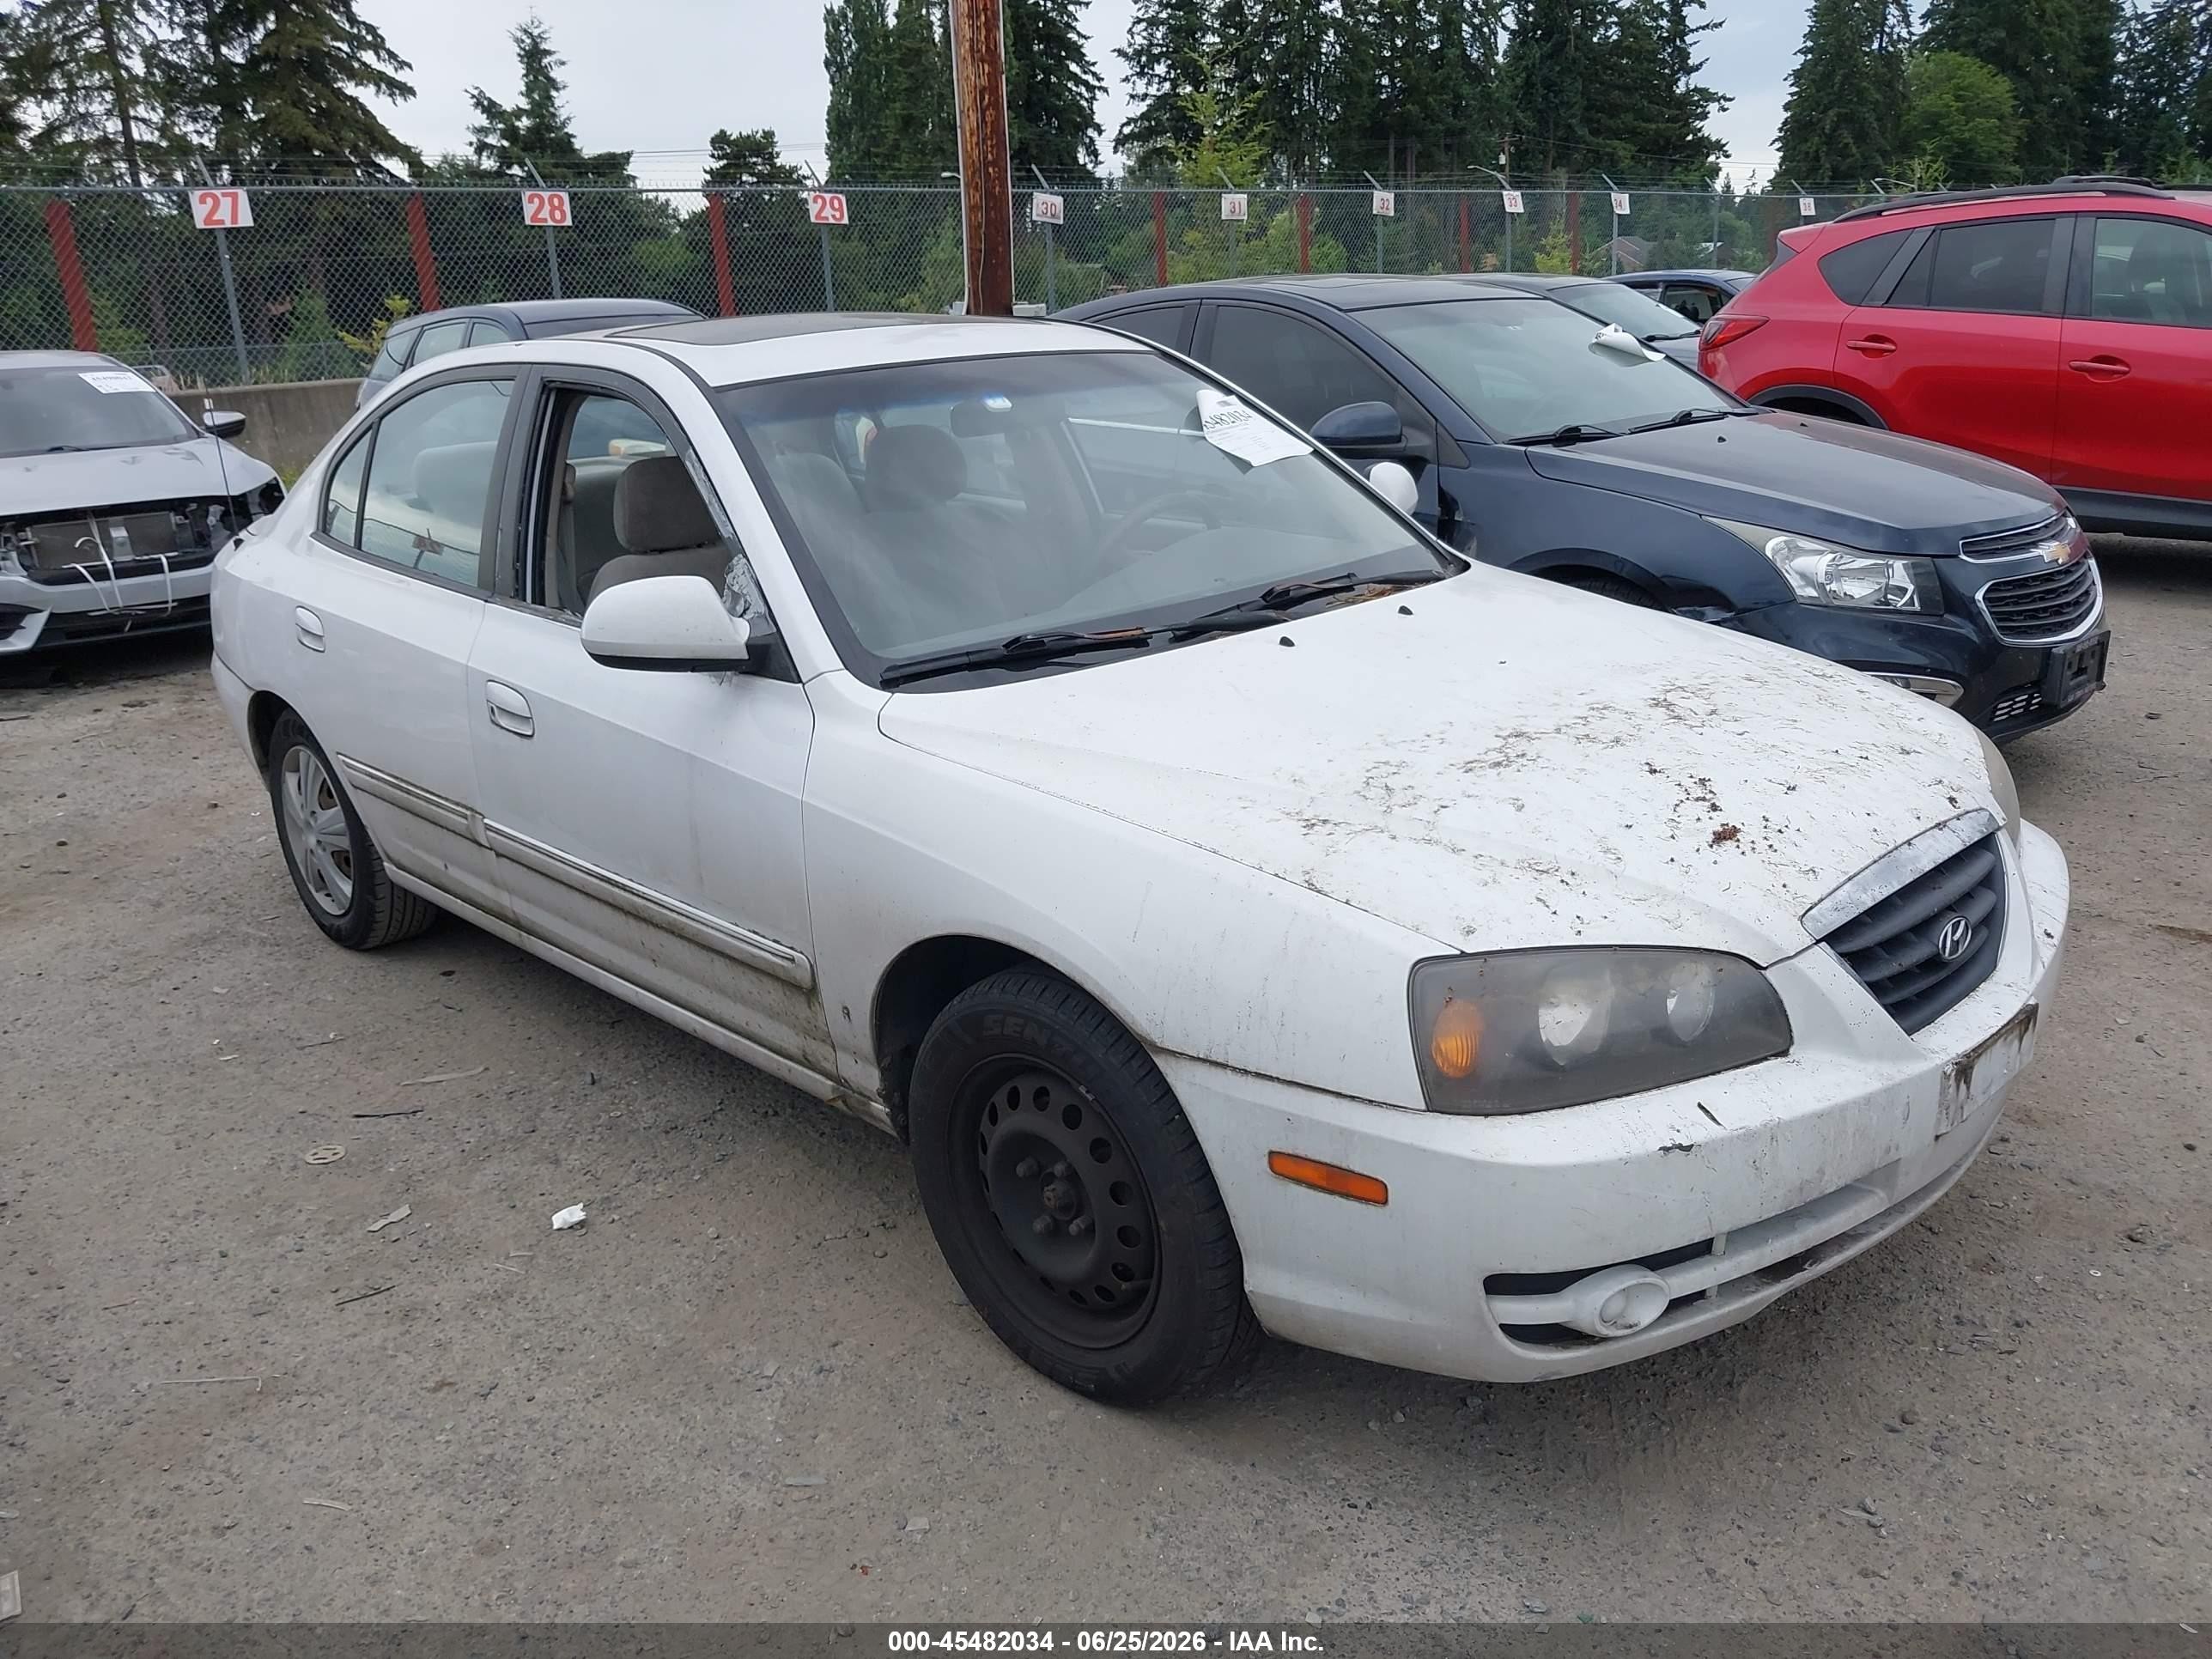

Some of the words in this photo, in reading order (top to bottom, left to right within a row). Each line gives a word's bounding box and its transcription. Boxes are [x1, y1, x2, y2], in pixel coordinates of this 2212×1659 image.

[198, 191, 239, 226] 27
[527, 192, 567, 224] 28
[811, 194, 845, 222] 29
[1041, 201, 1057, 217] 30
[1229, 201, 1242, 214] 31
[1380, 198, 1389, 210] 32
[1507, 197, 1517, 207] 33
